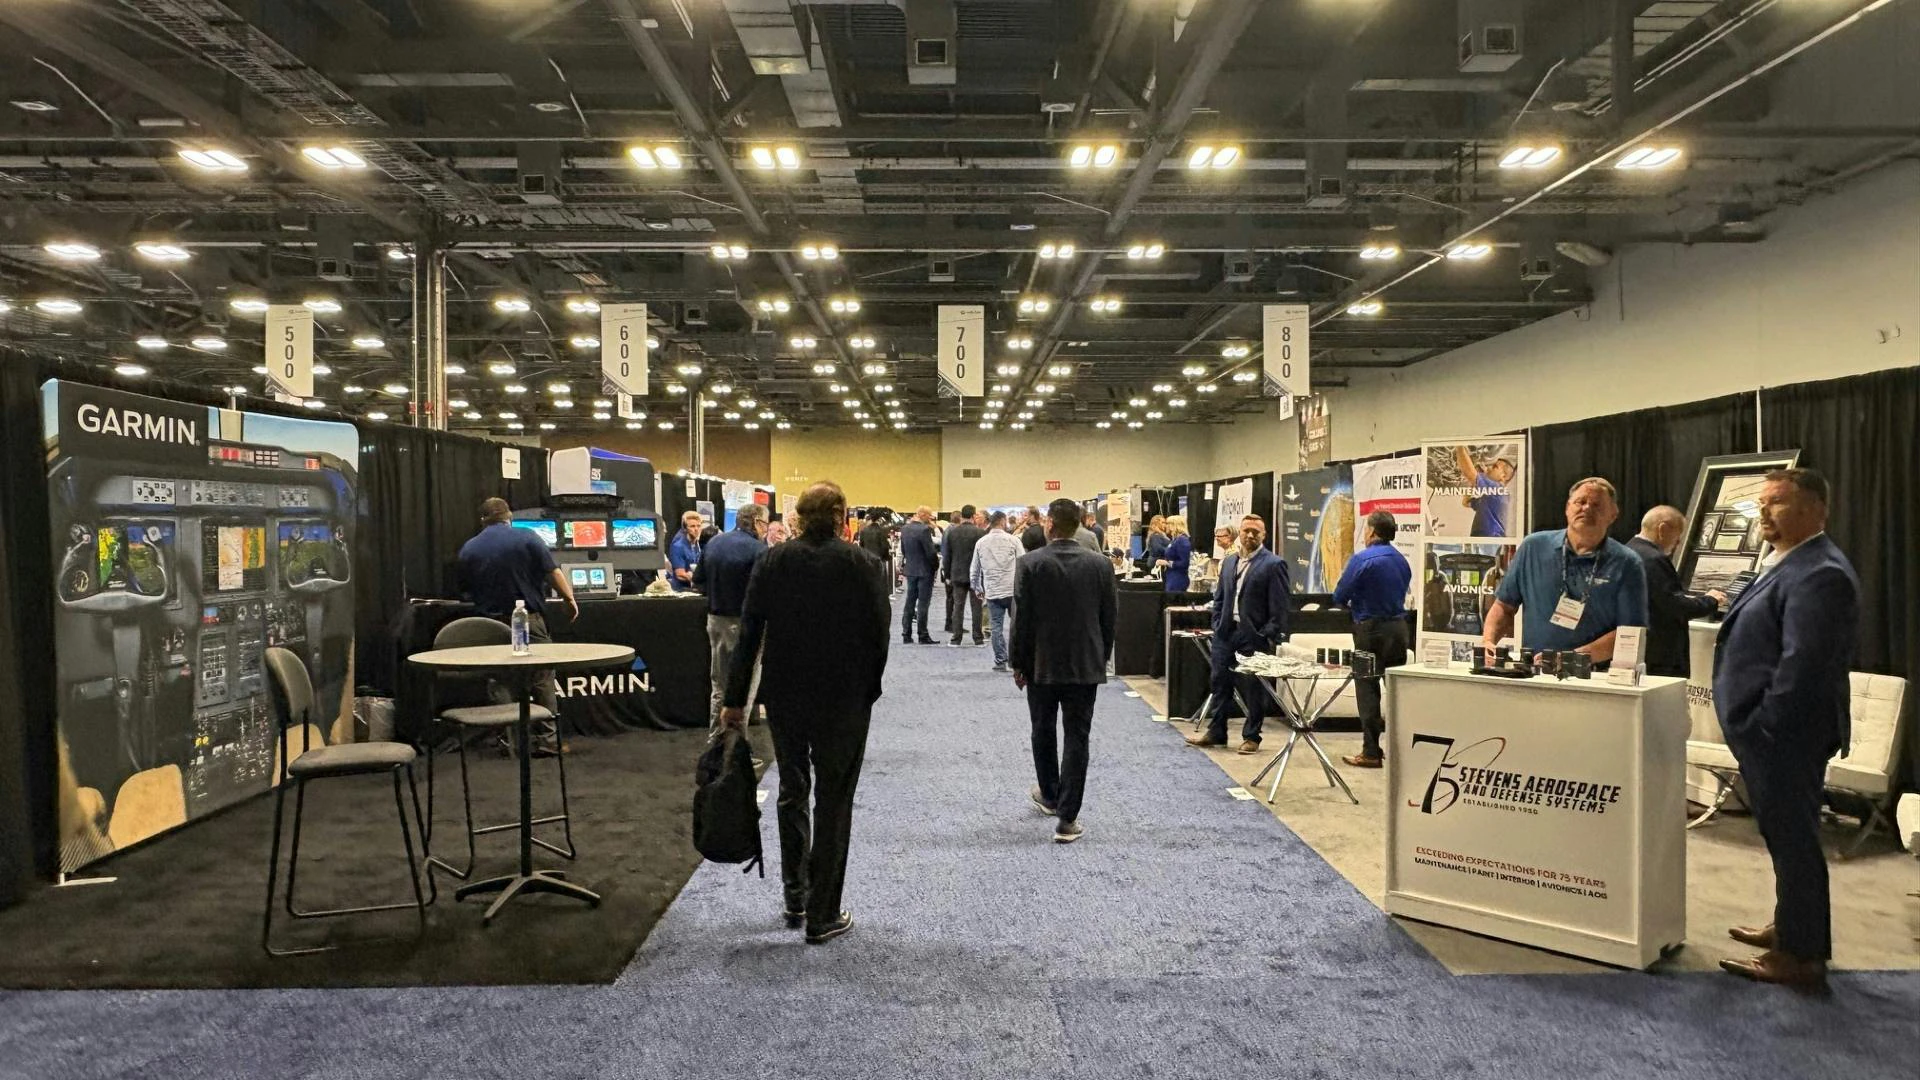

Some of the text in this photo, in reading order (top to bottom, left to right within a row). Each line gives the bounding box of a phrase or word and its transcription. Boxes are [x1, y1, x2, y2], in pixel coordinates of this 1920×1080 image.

[285, 326, 294, 378] 500
[620, 325, 629, 377] 600
[956, 326, 965, 378] 700
[1282, 326, 1291, 378] 800
[77, 403, 197, 446] GARMIN
[1380, 474, 1414, 490] AMETEK
[1432, 486, 1510, 498] MAINTENANCE
[1443, 585, 1494, 595] AVIONICS
[554, 672, 650, 698] ARMIN
[1459, 766, 1621, 803] STEVENS AEROSPACE
[1463, 784, 1606, 813] AND DEFENSE SYSTEMS
[1463, 799, 1516, 811] ESTABLISHED
[1414, 857, 1467, 873] MAINTENANCE
[1472, 867, 1495, 878] PAINT
[1500, 873, 1536, 887] INTERIOR
[1541, 881, 1583, 895] AVIONICS
[1415, 846, 1607, 888] EXCEEDING EXPECTATIONS FOR 75 YEARS
